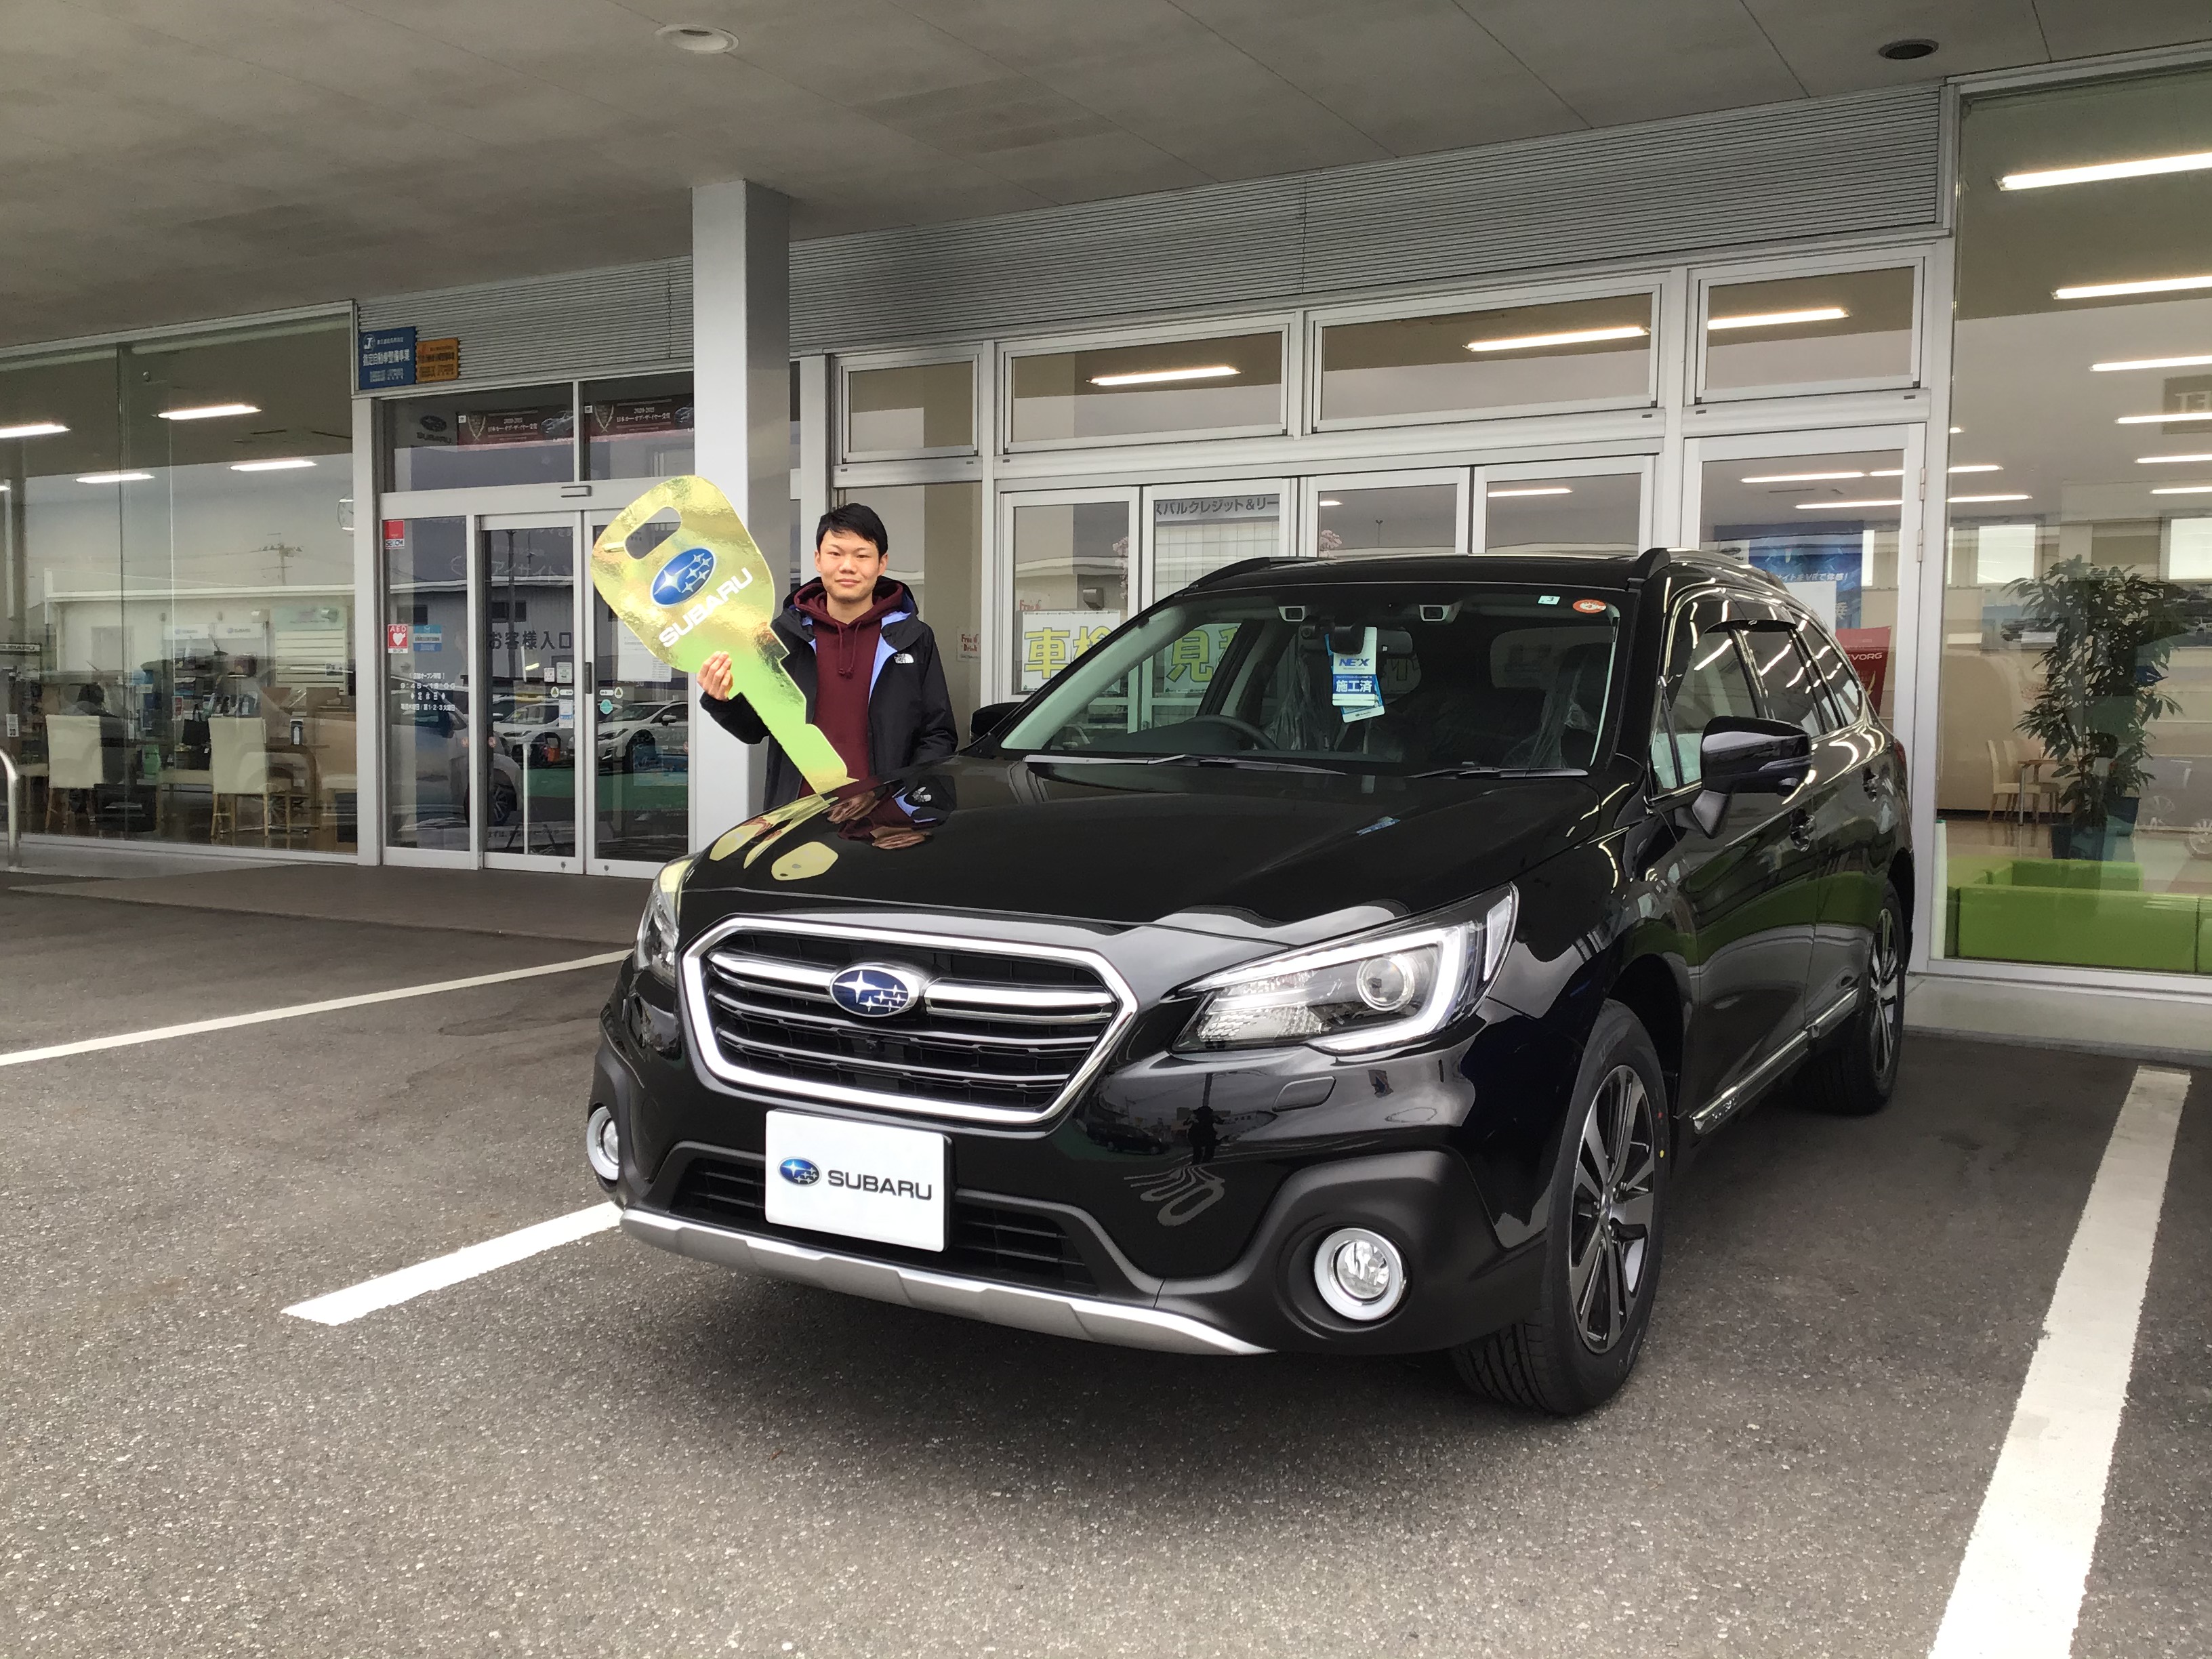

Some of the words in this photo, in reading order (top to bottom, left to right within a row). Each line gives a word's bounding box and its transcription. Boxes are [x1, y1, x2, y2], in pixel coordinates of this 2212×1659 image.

[659, 567, 754, 648] SUBARU
[1336, 679, 1372, 693] 施工済
[827, 1170, 933, 1201] SUBARU
